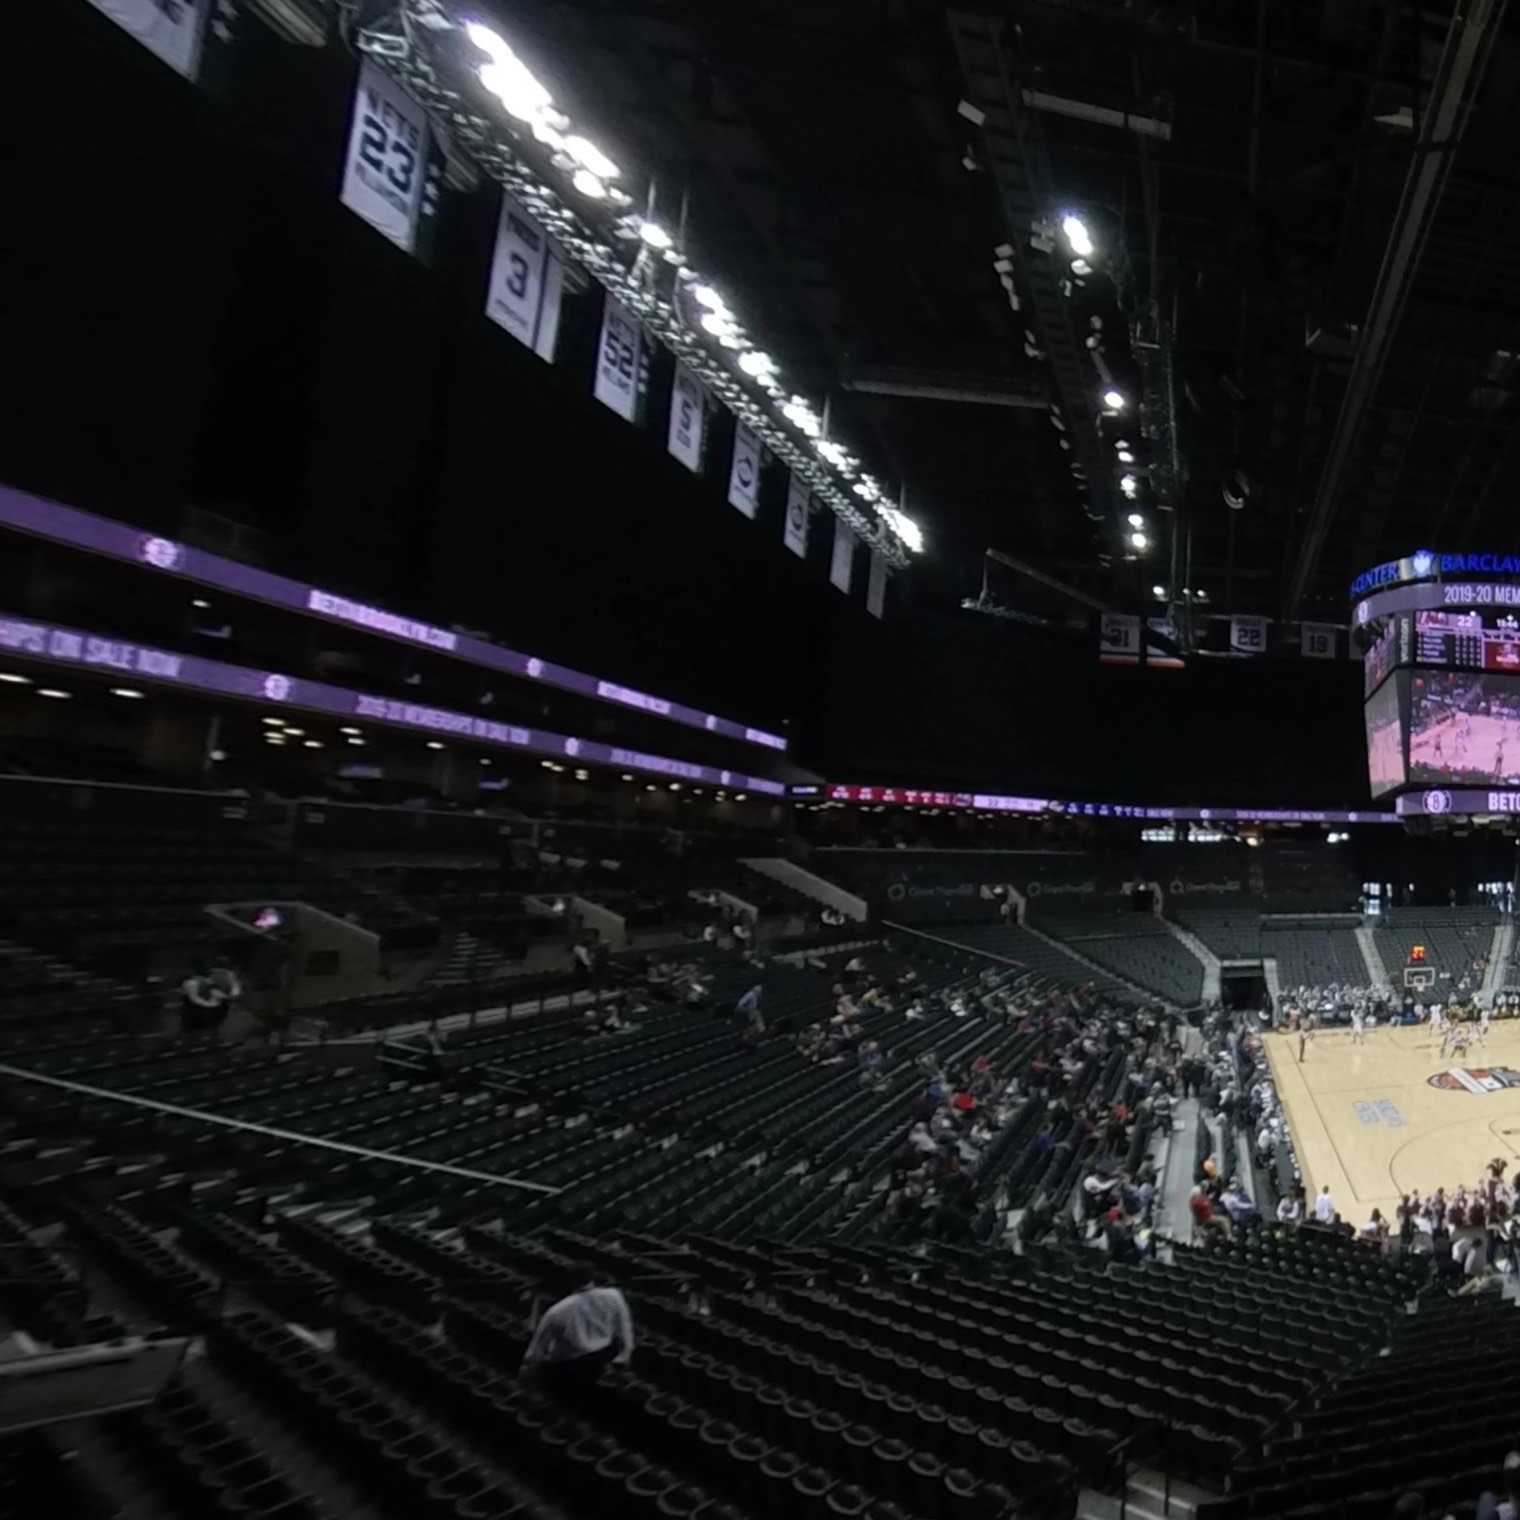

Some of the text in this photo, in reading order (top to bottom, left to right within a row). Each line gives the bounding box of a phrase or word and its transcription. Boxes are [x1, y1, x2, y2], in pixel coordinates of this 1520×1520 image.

[359, 114, 416, 194] 23
[506, 253, 528, 298] 3
[604, 330, 634, 380] 52
[1444, 586, 1492, 604] 2019-20
[1457, 615, 1473, 627] 22
[1238, 628, 1261, 647] 22
